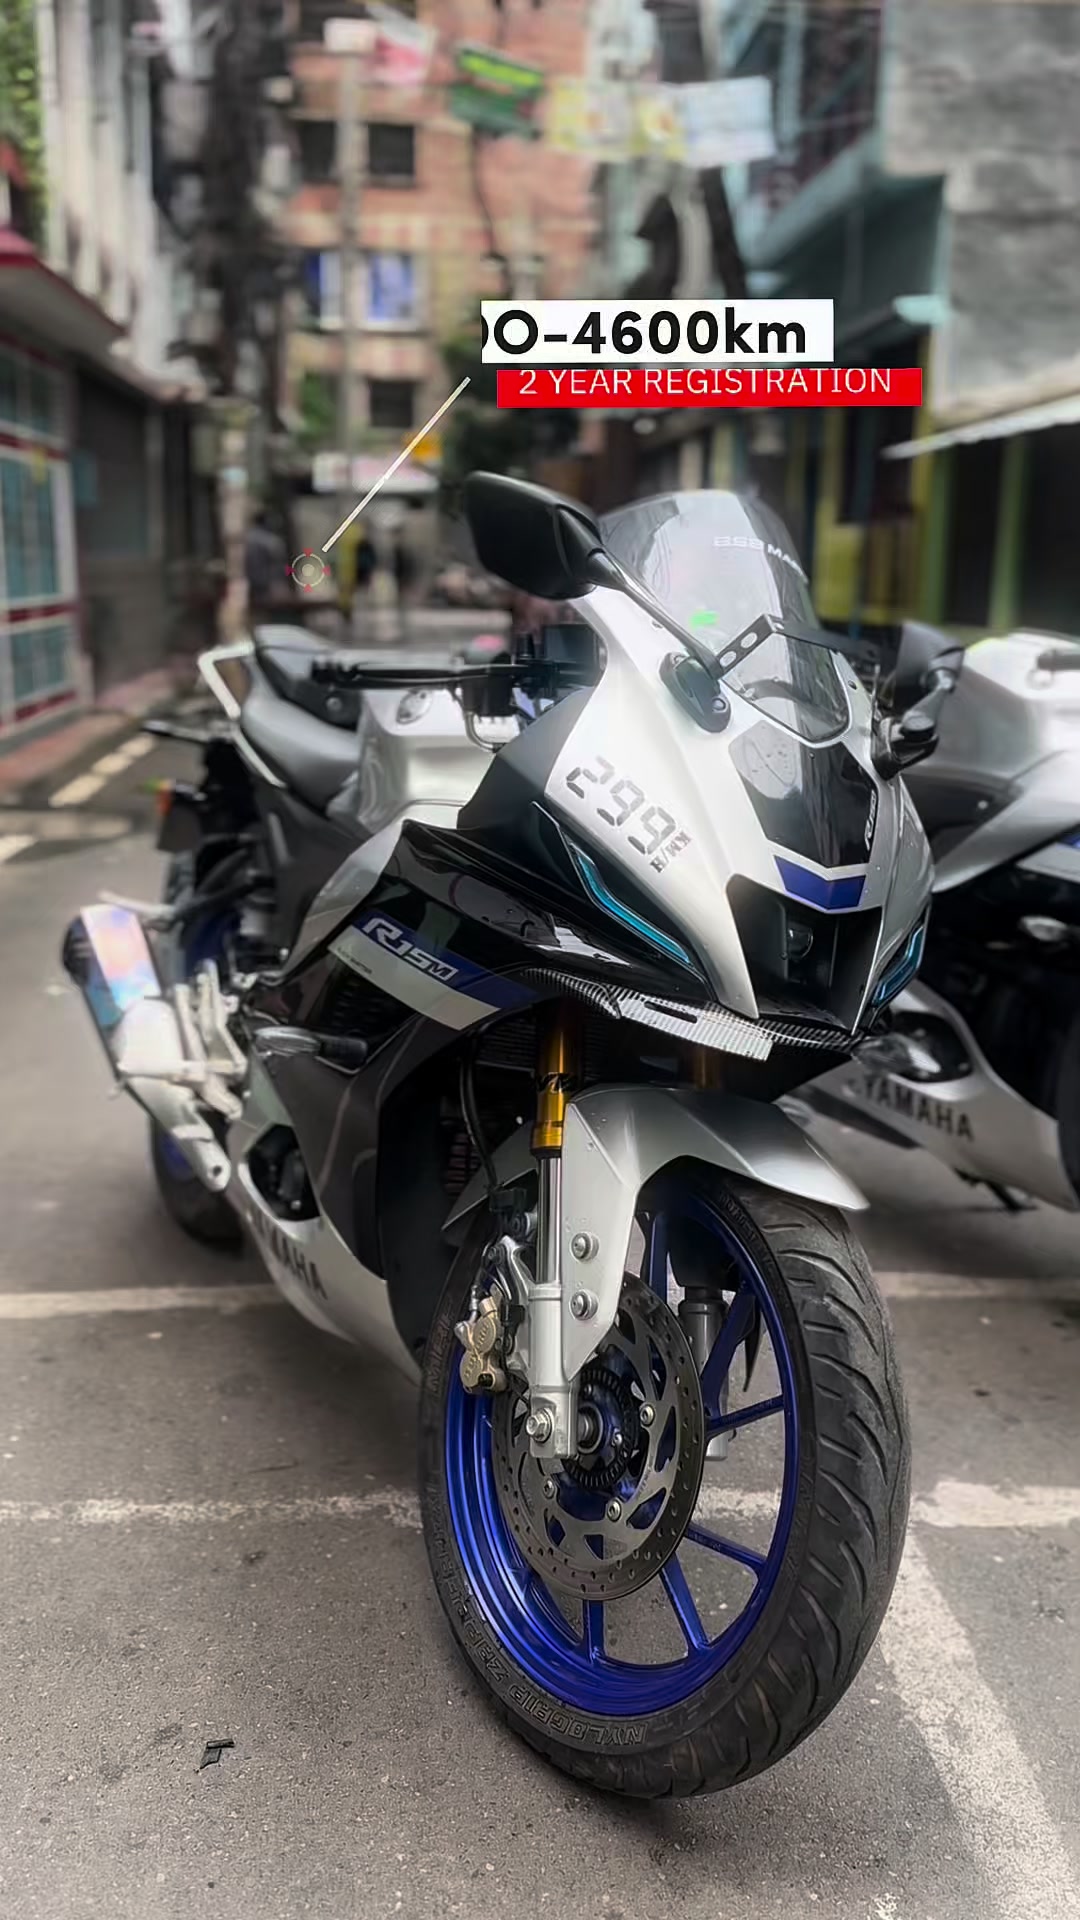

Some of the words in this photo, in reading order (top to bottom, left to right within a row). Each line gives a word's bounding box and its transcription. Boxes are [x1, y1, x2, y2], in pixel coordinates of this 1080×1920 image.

[566, 755, 677, 855] 299
[866, 1077, 975, 1142] YAMAHA
[509, 1684, 648, 1745] NYLOGRIP
